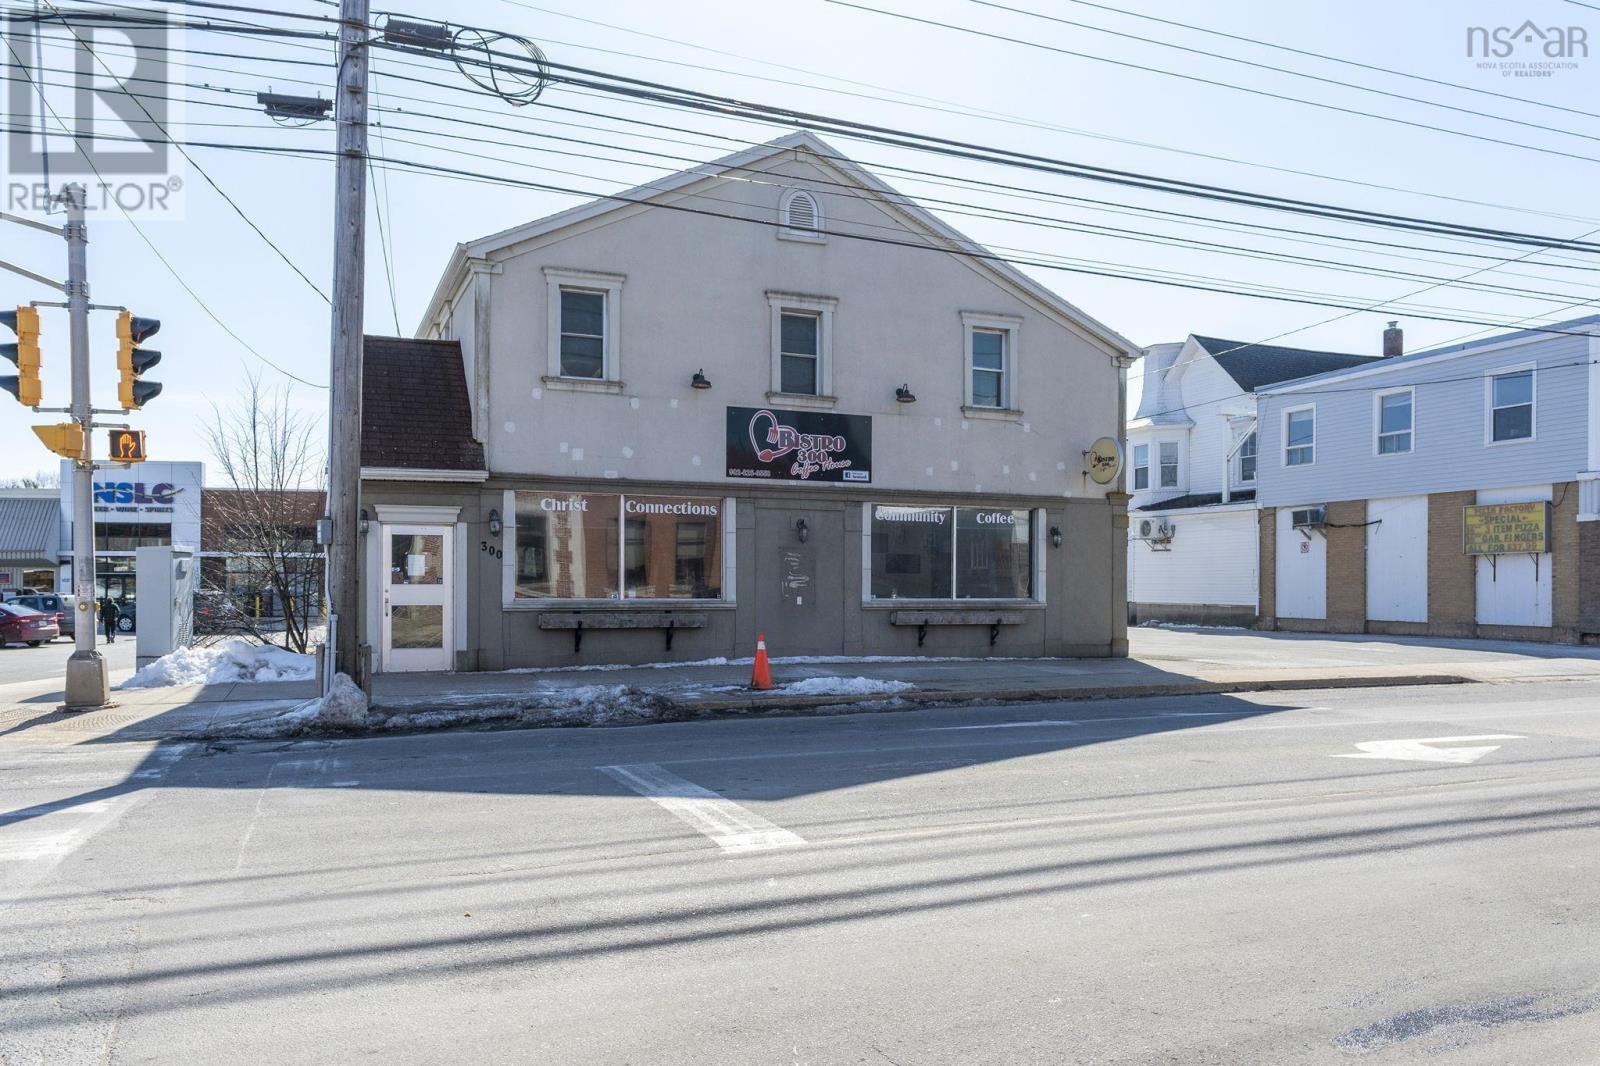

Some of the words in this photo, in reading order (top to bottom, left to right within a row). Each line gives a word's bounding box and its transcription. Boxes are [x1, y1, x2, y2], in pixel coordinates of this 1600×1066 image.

[797, 450, 828, 463] 300
[791, 461, 819, 479] Coffee
[822, 457, 851, 471] House
[94, 482, 174, 504] NSLC
[540, 498, 589, 512] Christ
[625, 500, 718, 515] Connections
[976, 512, 1015, 524] Coffee
[1484, 514, 1522, 524] SPECIAL
[481, 541, 503, 559] 300
